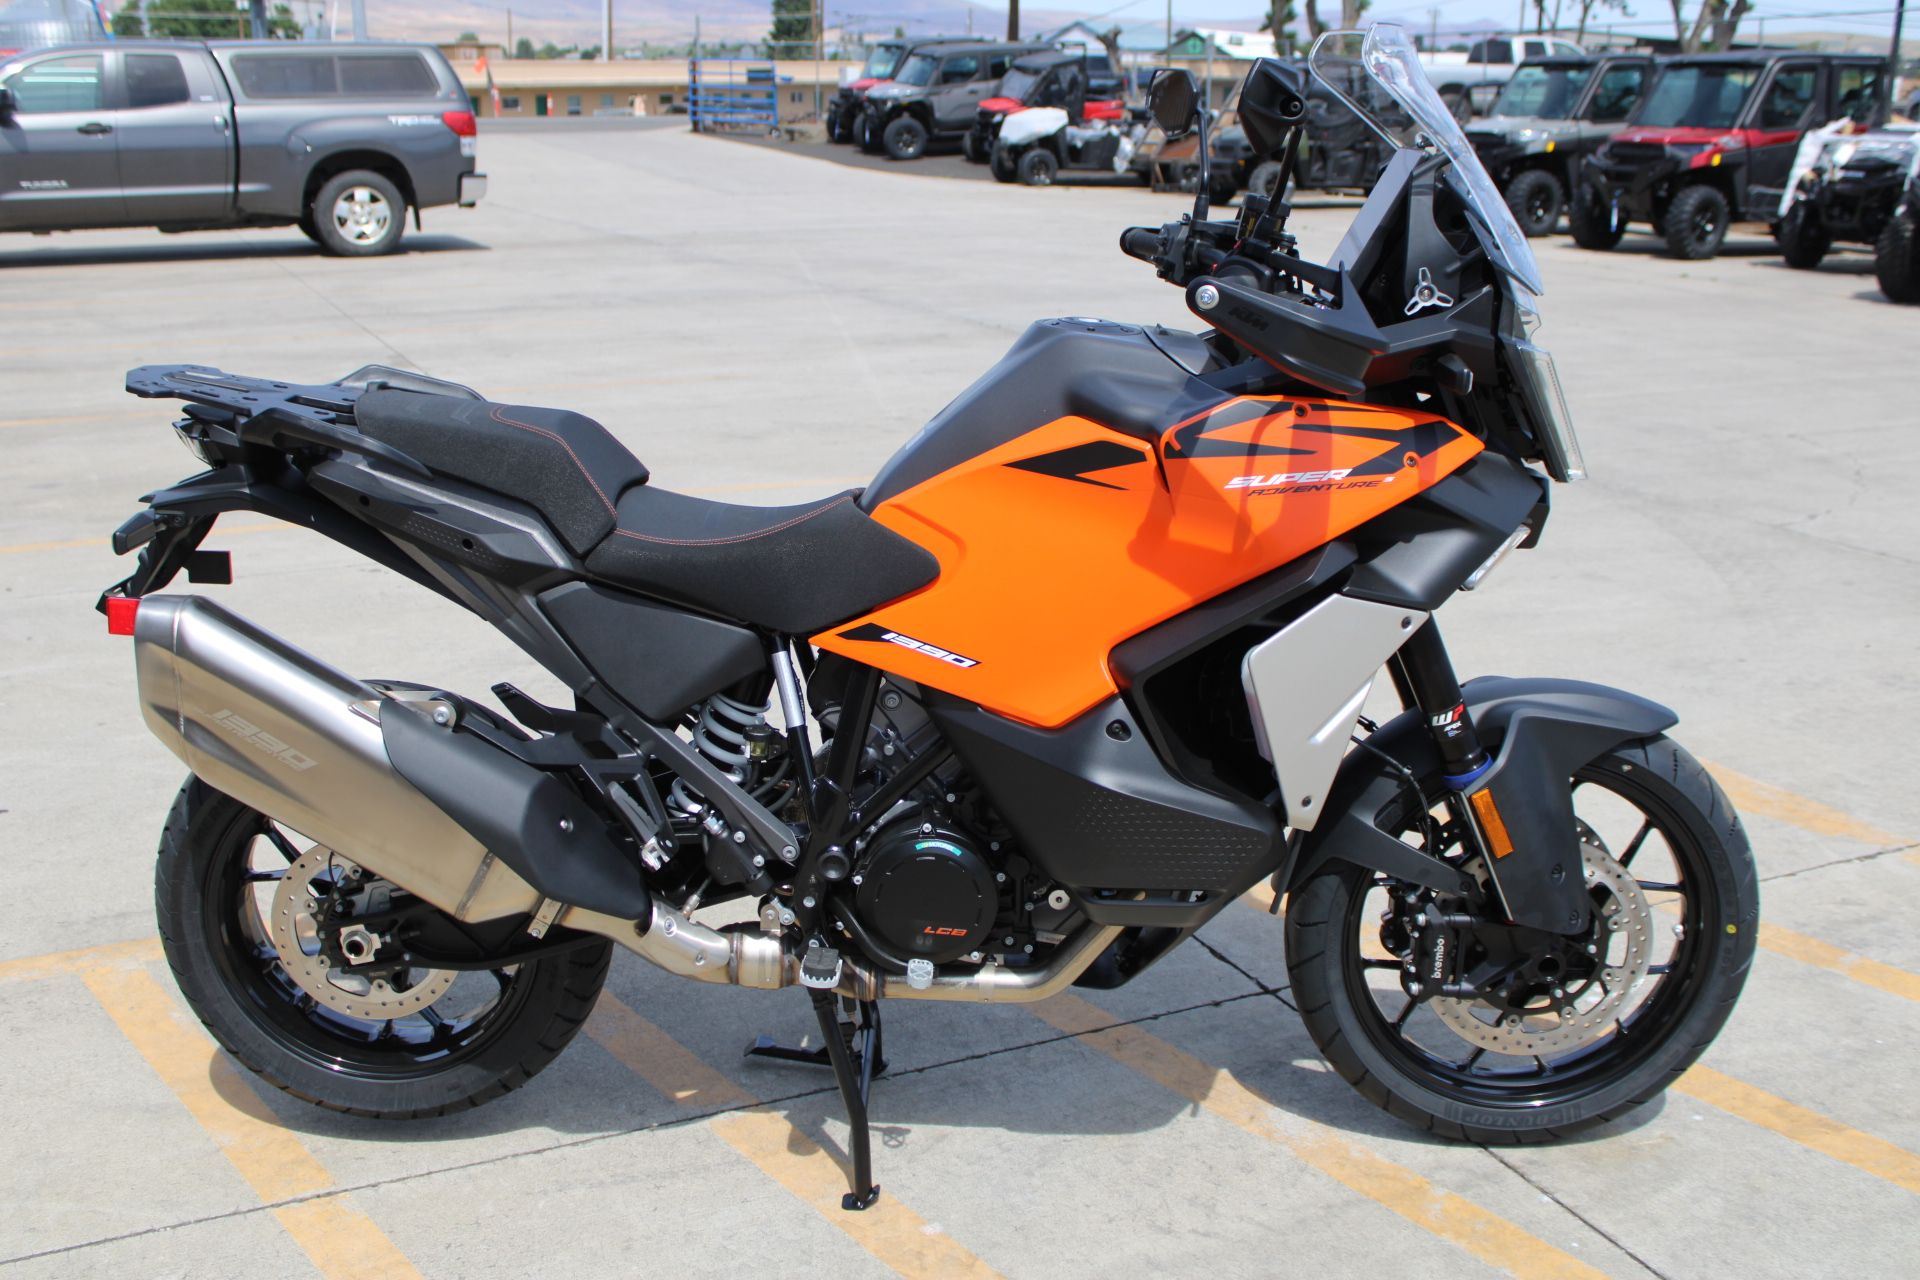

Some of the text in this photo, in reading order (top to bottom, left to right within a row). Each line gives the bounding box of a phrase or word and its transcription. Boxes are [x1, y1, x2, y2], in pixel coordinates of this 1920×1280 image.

[1224, 468, 1353, 489] SUPER
[1248, 480, 1383, 497] ADVENTURE
[881, 632, 977, 668] 1390
[1431, 703, 1465, 727] WP
[923, 926, 968, 937] LC8
[1431, 938, 1445, 979] brembo
[1465, 1113, 1549, 1127] DUNLOP
